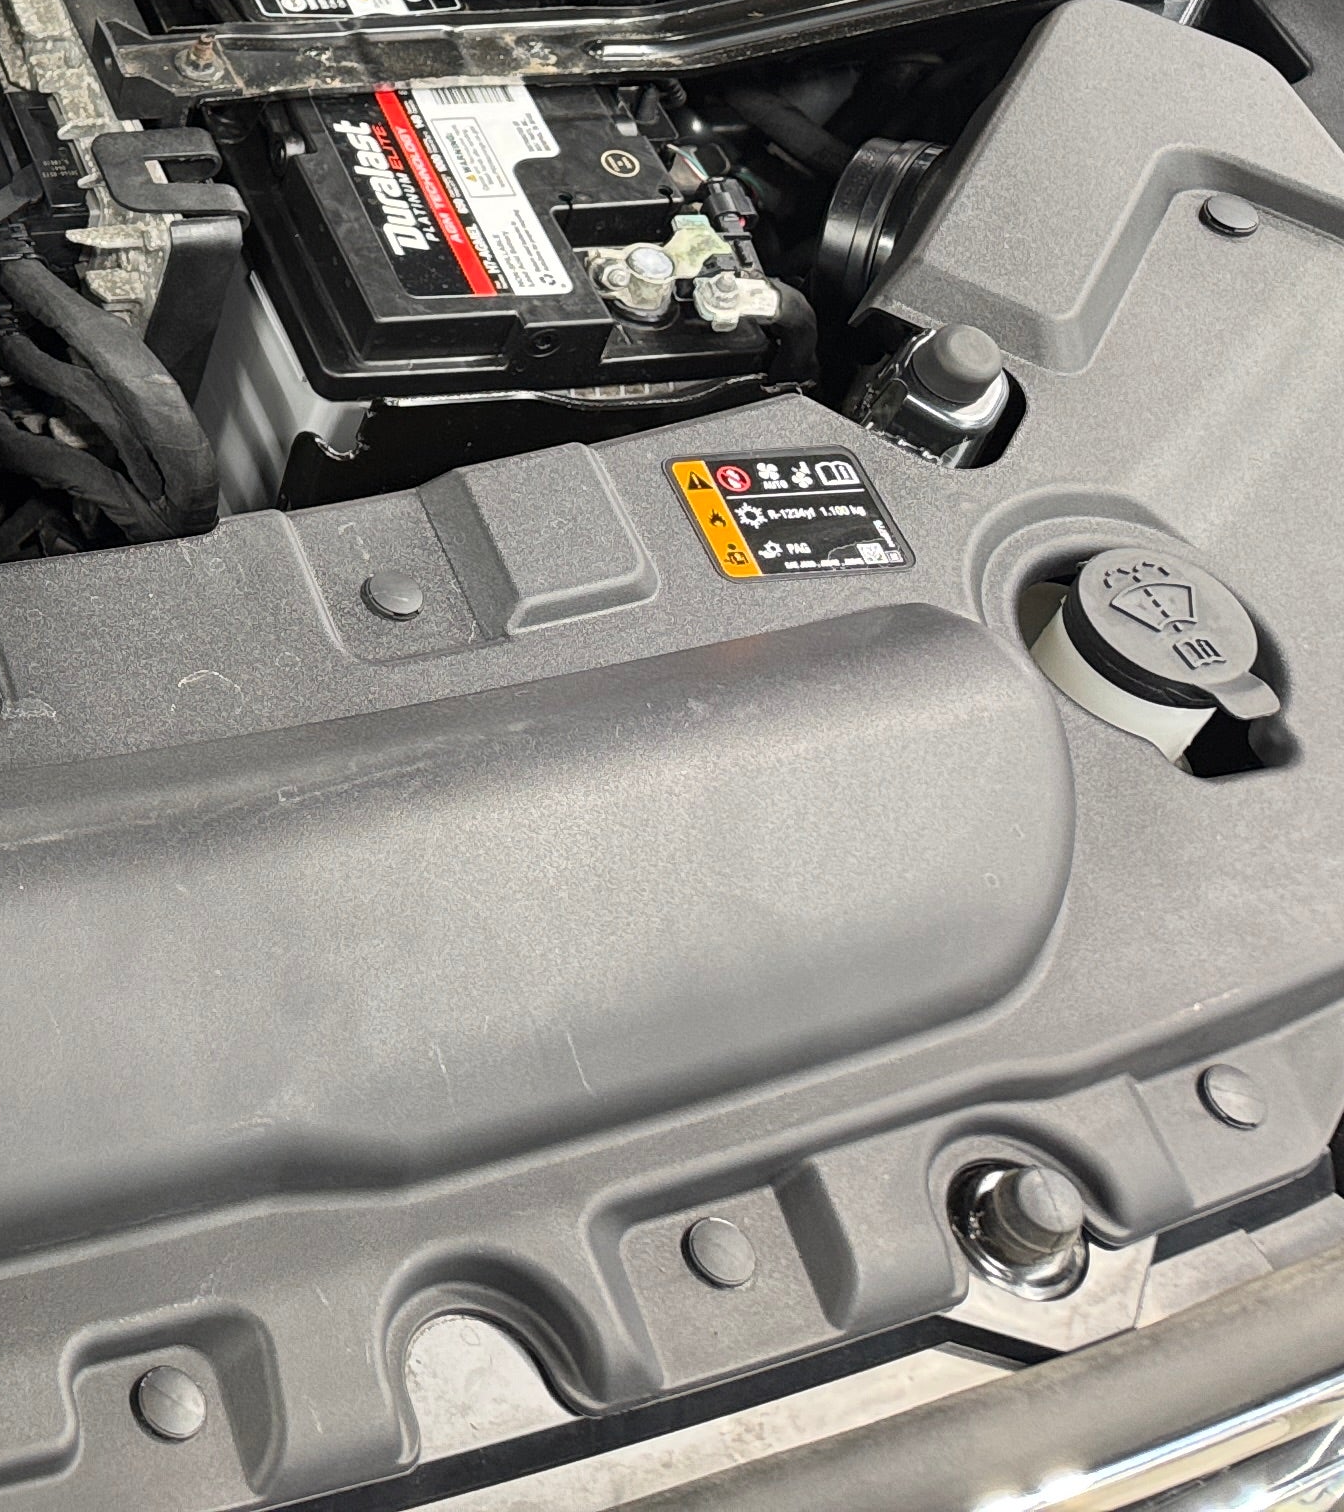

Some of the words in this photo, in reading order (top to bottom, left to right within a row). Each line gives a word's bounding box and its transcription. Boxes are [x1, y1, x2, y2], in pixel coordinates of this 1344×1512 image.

[370, 122, 405, 171] ELITE
[394, 125, 447, 209] TECHNOLOGY
[332, 119, 431, 256] Duralast
[395, 172, 441, 243] PLATINUM
[438, 212, 464, 244] AGM
[763, 479, 789, 490] AUTO
[767, 506, 817, 520] R-1234yf
[849, 504, 867, 517] kg
[786, 542, 812, 555] PAG
